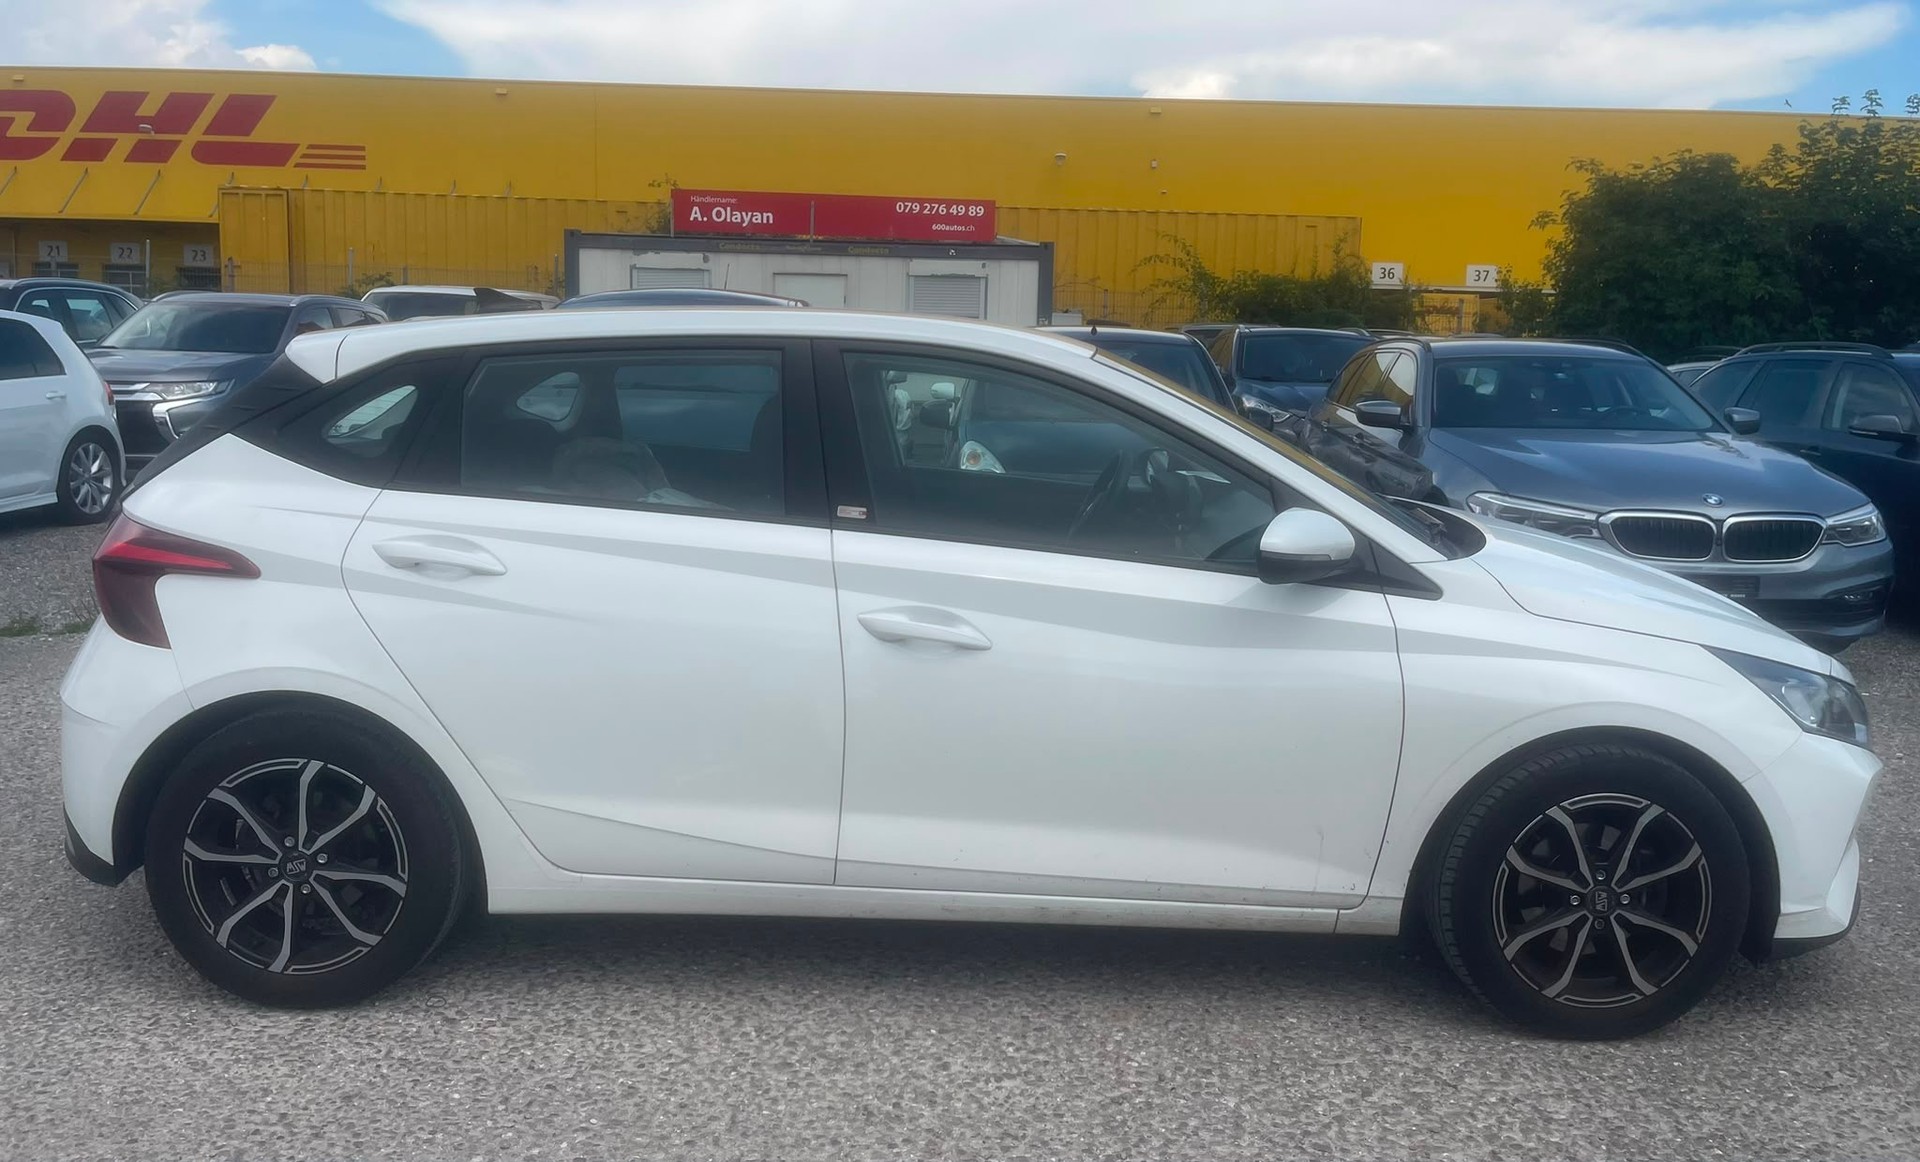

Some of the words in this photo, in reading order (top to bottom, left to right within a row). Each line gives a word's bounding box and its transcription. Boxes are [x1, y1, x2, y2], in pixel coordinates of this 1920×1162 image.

[896, 202, 920, 213] 079
[923, 203, 947, 215] 276
[949, 205, 966, 216] 49
[968, 206, 985, 217] 89
[690, 206, 708, 221] A.
[712, 207, 774, 227] Olayan
[931, 223, 976, 232] 600autos.ch
[47, 245, 60, 257] 21
[118, 247, 133, 259] 22
[191, 249, 207, 261] 23
[1379, 267, 1395, 280] 36
[1473, 269, 1490, 282] 37
